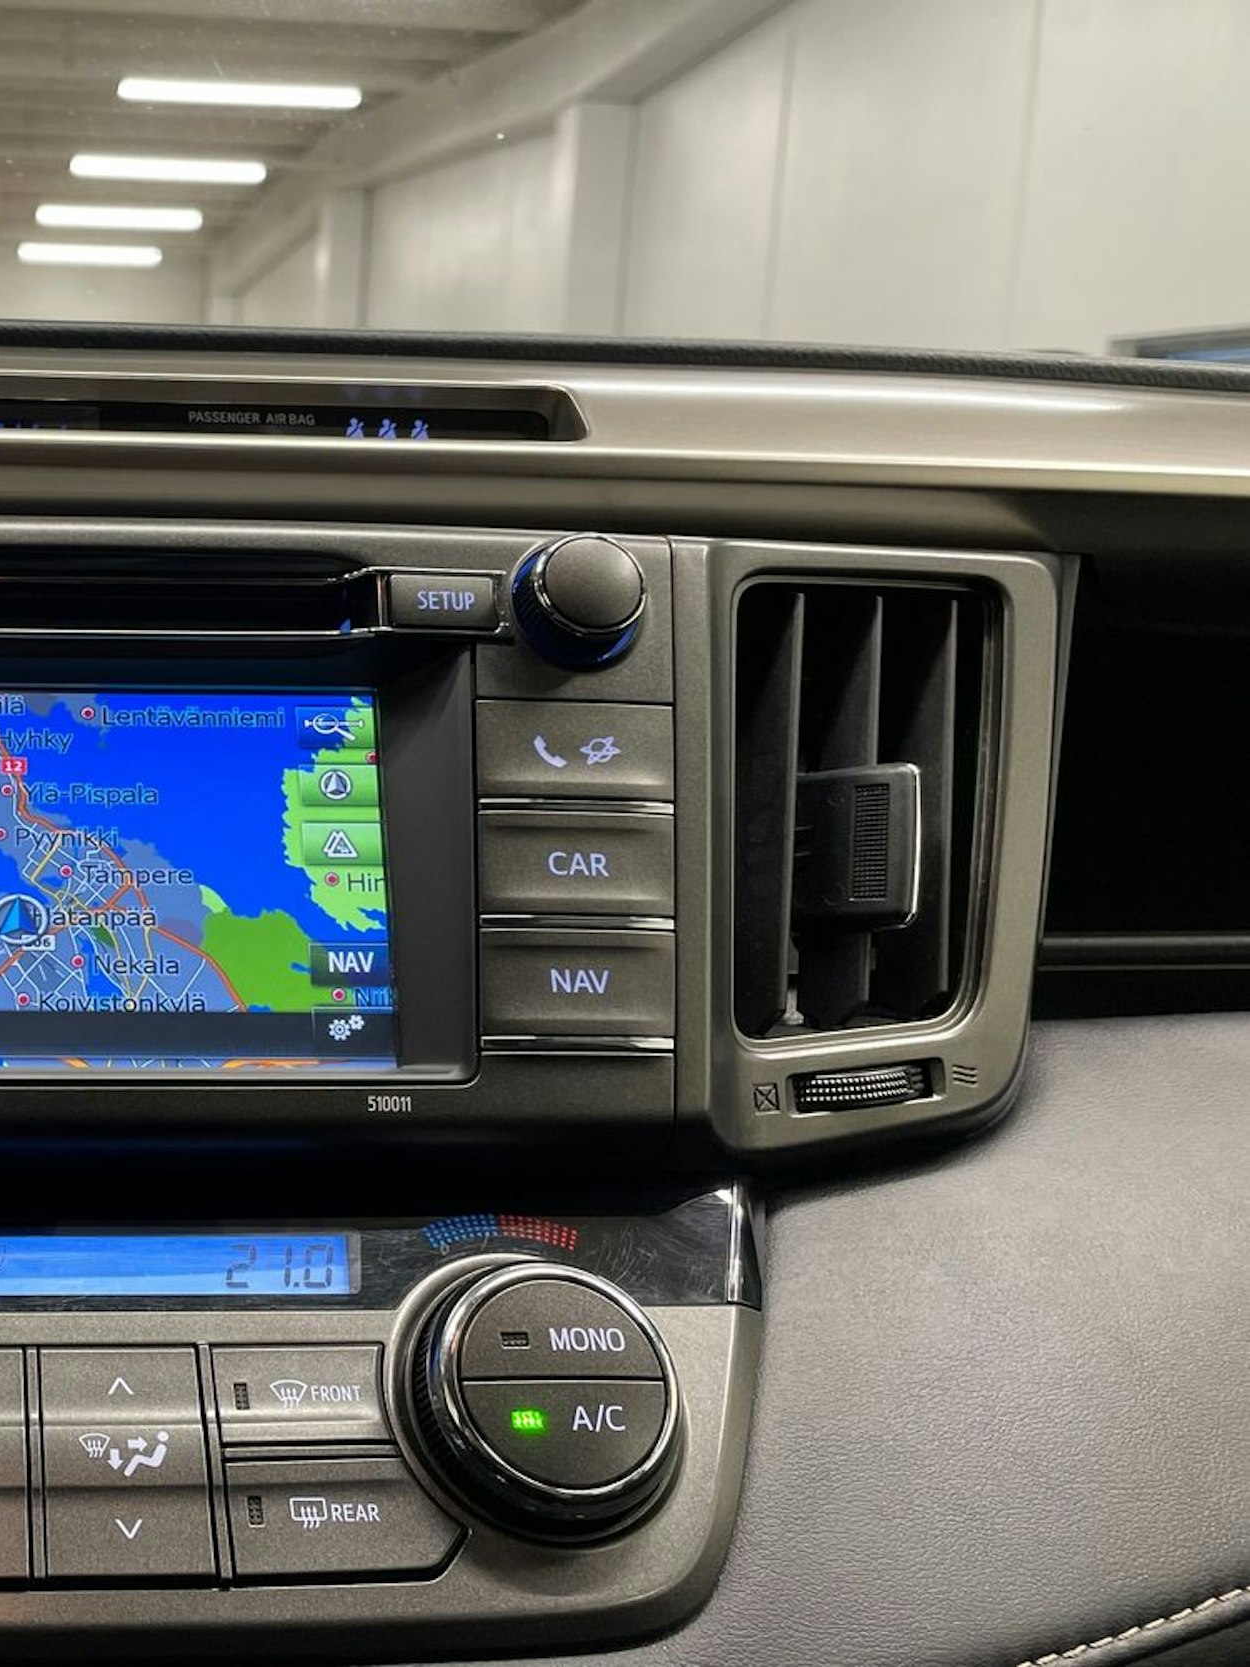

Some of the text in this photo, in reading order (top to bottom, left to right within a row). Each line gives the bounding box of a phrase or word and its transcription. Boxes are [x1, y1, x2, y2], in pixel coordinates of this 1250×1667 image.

[188, 411, 261, 425] PASSENGER
[417, 590, 475, 612] SETUP
[102, 706, 285, 728] Lentävänniemi
[2, 760, 25, 772] 12
[23, 783, 158, 808] Ylä-Pispala
[16, 827, 118, 850] Pyynikki
[84, 865, 192, 884] Tampere
[548, 852, 609, 877] CAR
[94, 957, 180, 975] Nekala
[328, 951, 374, 973] NAV
[550, 969, 609, 993] NAV
[39, 992, 205, 1012] Koivistonkylä
[367, 1096, 412, 1112] 510011
[225, 1245, 334, 1288] 21.0
[549, 1328, 625, 1351] MONO
[311, 1385, 361, 1401] FRONT
[572, 1405, 626, 1432] A/C
[330, 1504, 380, 1522] REAR
